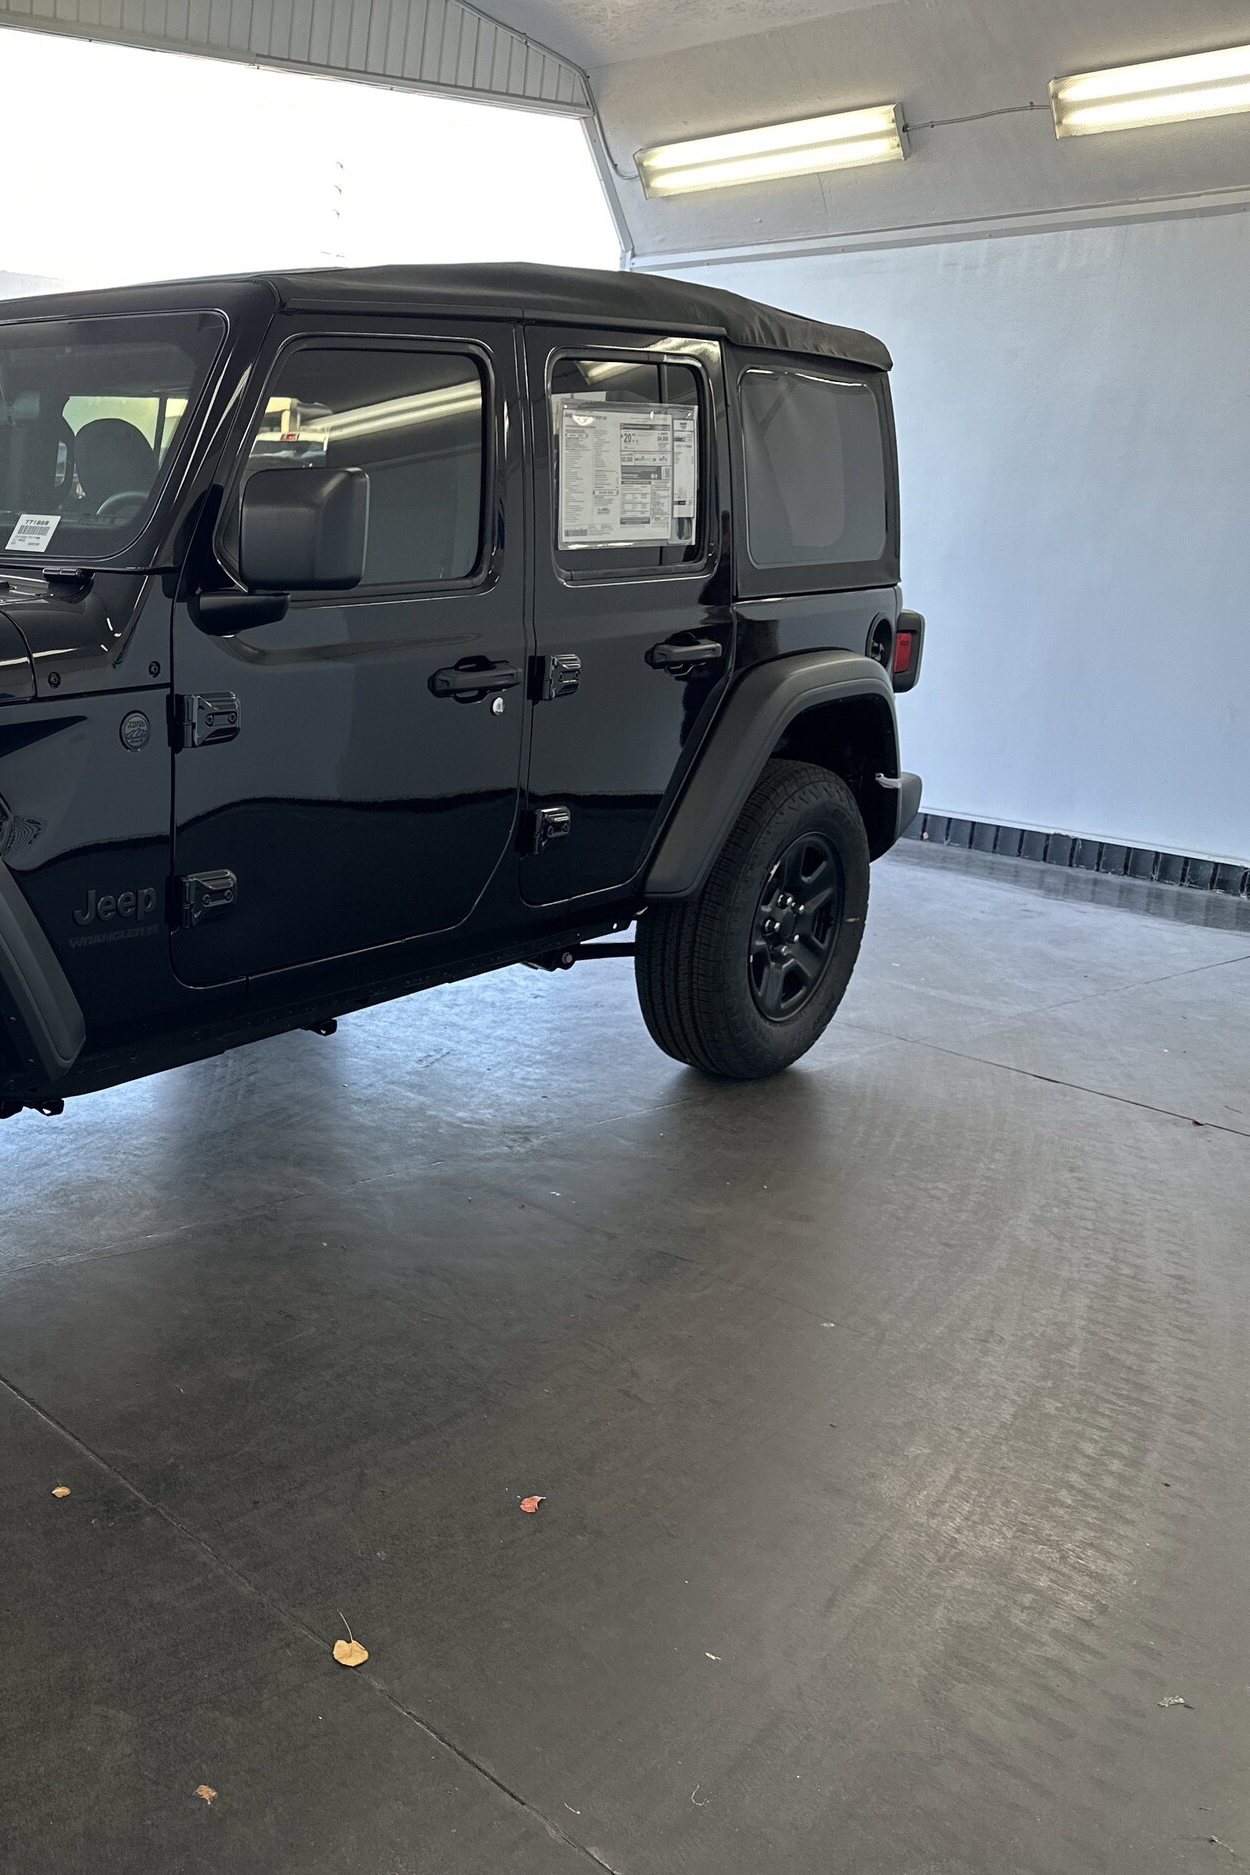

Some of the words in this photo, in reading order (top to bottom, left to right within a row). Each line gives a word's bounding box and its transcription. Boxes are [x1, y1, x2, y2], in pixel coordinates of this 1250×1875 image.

[623, 433, 632, 443] 20
[73, 887, 158, 925] Jeep
[68, 927, 146, 949] WRANGLER
